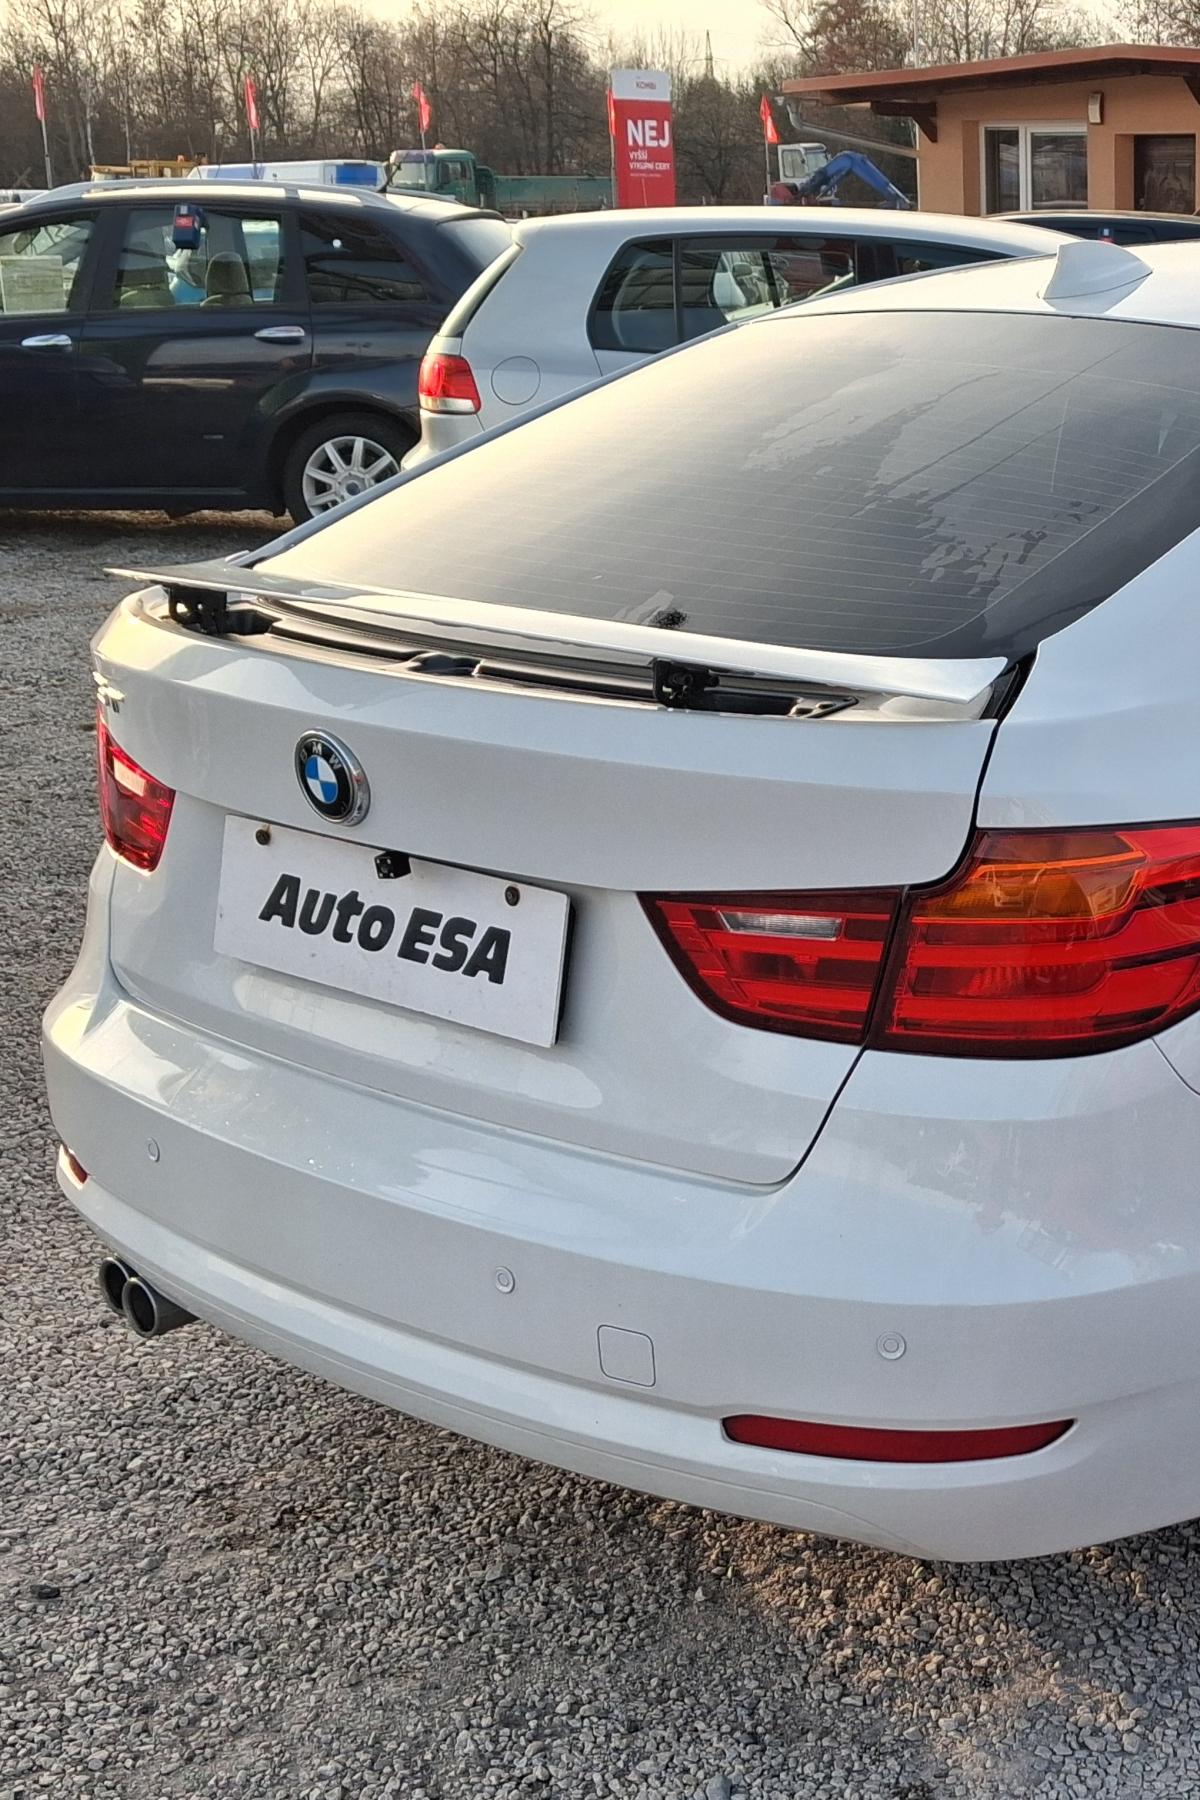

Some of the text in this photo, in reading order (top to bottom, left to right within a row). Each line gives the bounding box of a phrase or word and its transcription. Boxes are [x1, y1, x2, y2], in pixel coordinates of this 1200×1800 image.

[627, 119, 670, 147] NEJ
[299, 741, 342, 770] BMW
[258, 874, 511, 985] Auto ESA
